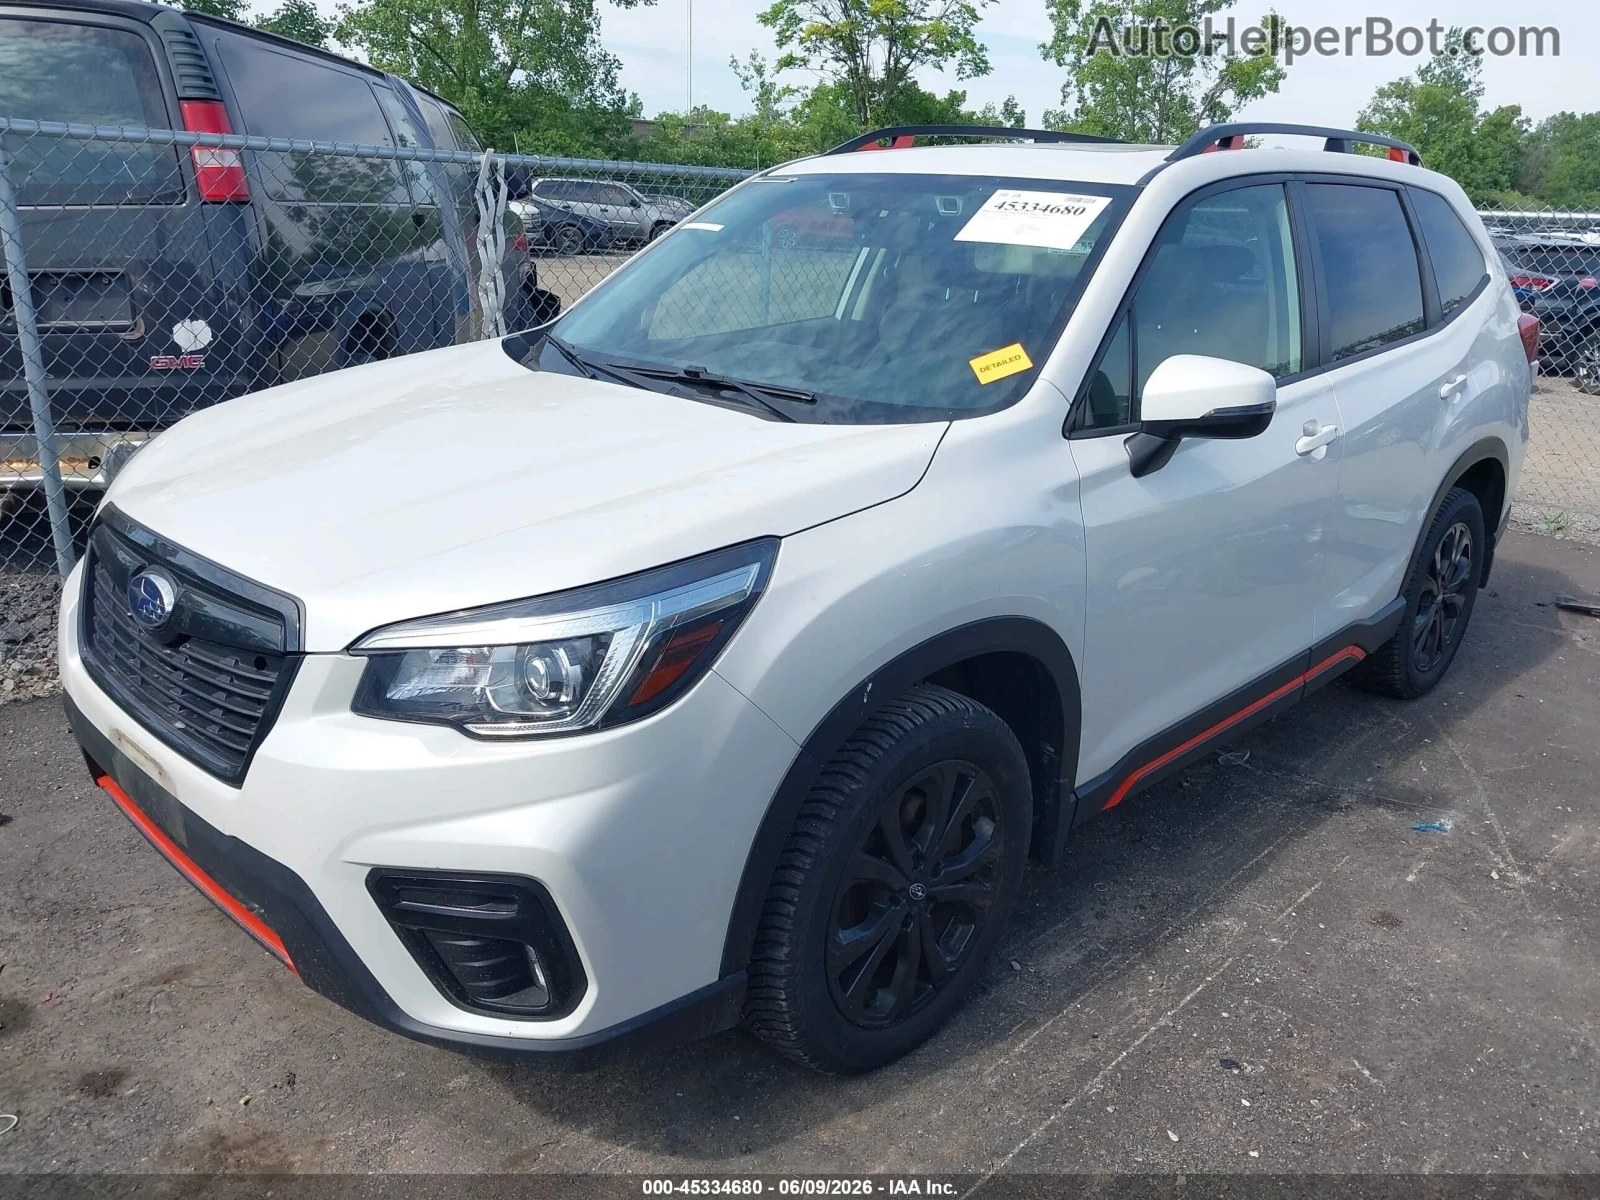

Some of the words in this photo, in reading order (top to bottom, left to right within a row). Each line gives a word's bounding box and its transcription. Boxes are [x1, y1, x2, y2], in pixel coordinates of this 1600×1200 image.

[993, 200, 1087, 217] 45334680
[150, 355, 205, 369] GMC
[979, 354, 1022, 373] DETAILED
